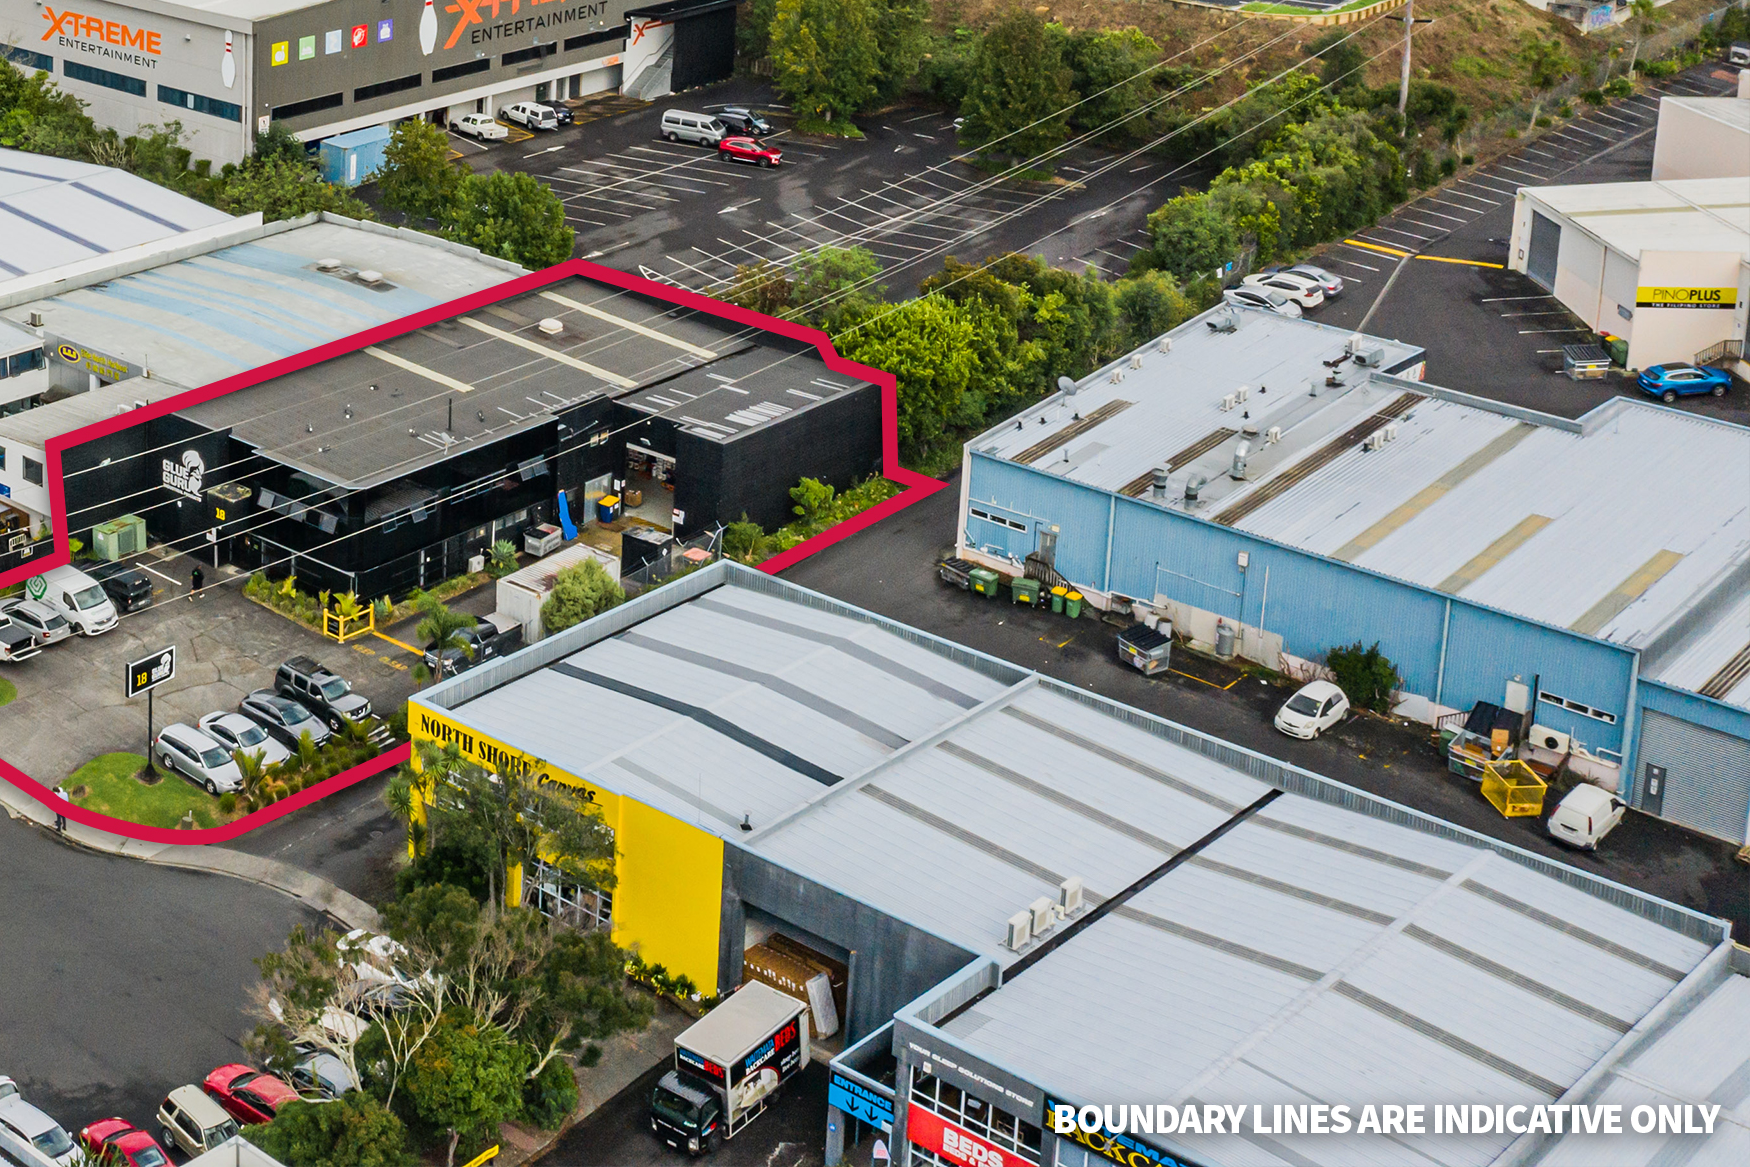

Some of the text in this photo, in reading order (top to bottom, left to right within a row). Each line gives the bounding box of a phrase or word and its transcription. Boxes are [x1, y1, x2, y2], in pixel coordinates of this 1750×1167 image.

[41, 6, 162, 56] XTREME
[471, 0, 608, 44] ENTERTAINMENT
[58, 36, 158, 70] ENTERTAINMENT
[1653, 288, 1721, 302] PINOPLUS
[162, 458, 190, 480] GLUE
[162, 470, 191, 492] GURU
[215, 507, 226, 521] 18
[136, 671, 148, 687] 18
[421, 713, 474, 755] NORTH
[774, 1021, 797, 1052] BEDS
[703, 1060, 725, 1079] BEDS
[745, 1048, 775, 1075] BACKCARE
[909, 1042, 1034, 1108] YOUR SLEEP SOLUTIONS STORE
[833, 1074, 893, 1113] ENTRANCE
[942, 1127, 1004, 1167] BEDS
[942, 1143, 968, 1161] BEDS
